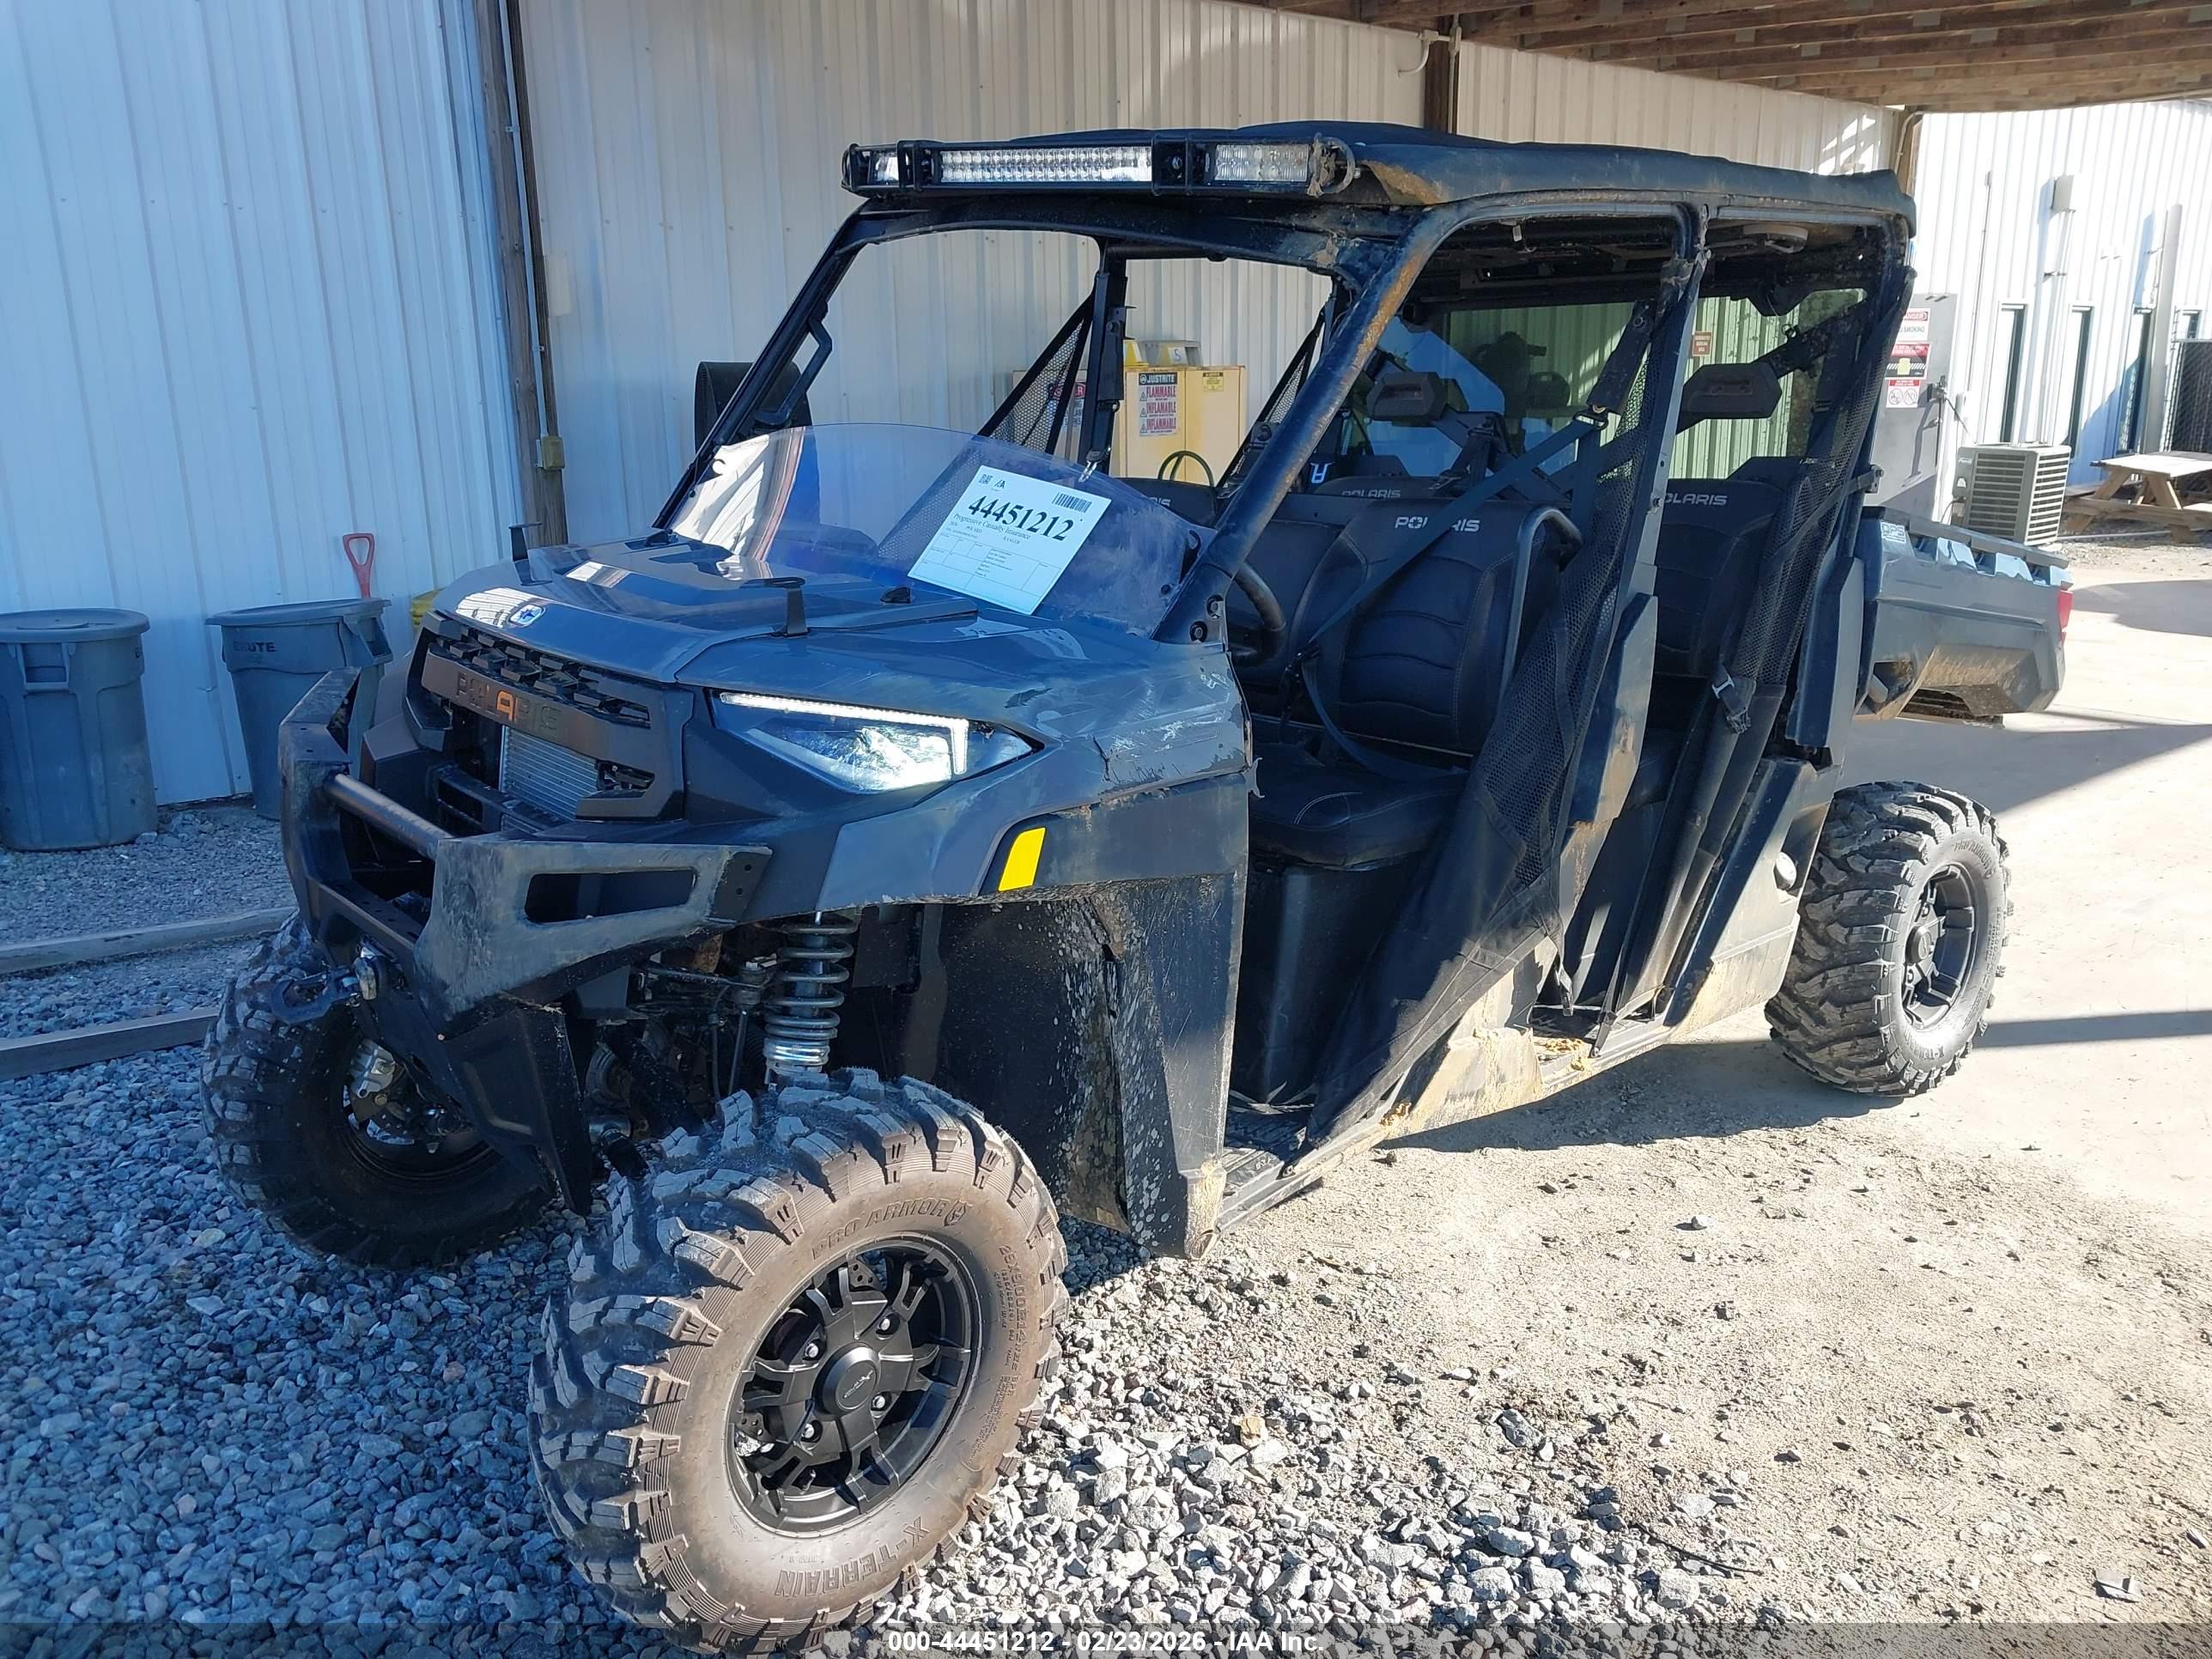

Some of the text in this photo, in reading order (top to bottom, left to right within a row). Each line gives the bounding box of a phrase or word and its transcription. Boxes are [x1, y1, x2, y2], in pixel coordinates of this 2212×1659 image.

[1146, 386, 1176, 398] FLAMMABLE
[1147, 374, 1176, 384] JUSTRITE
[1341, 489, 1402, 500] POLARIS
[1665, 492, 1728, 506] OLARIS
[953, 514, 982, 526] Progressive
[981, 520, 1005, 533] Casualty
[1005, 527, 1031, 540] Insurance
[969, 495, 1074, 541] 44451212
[457, 671, 562, 731] POLARIS
[811, 1197, 951, 1261] PRO ARMOR
[775, 1516, 932, 1598] X-TERRAIN
